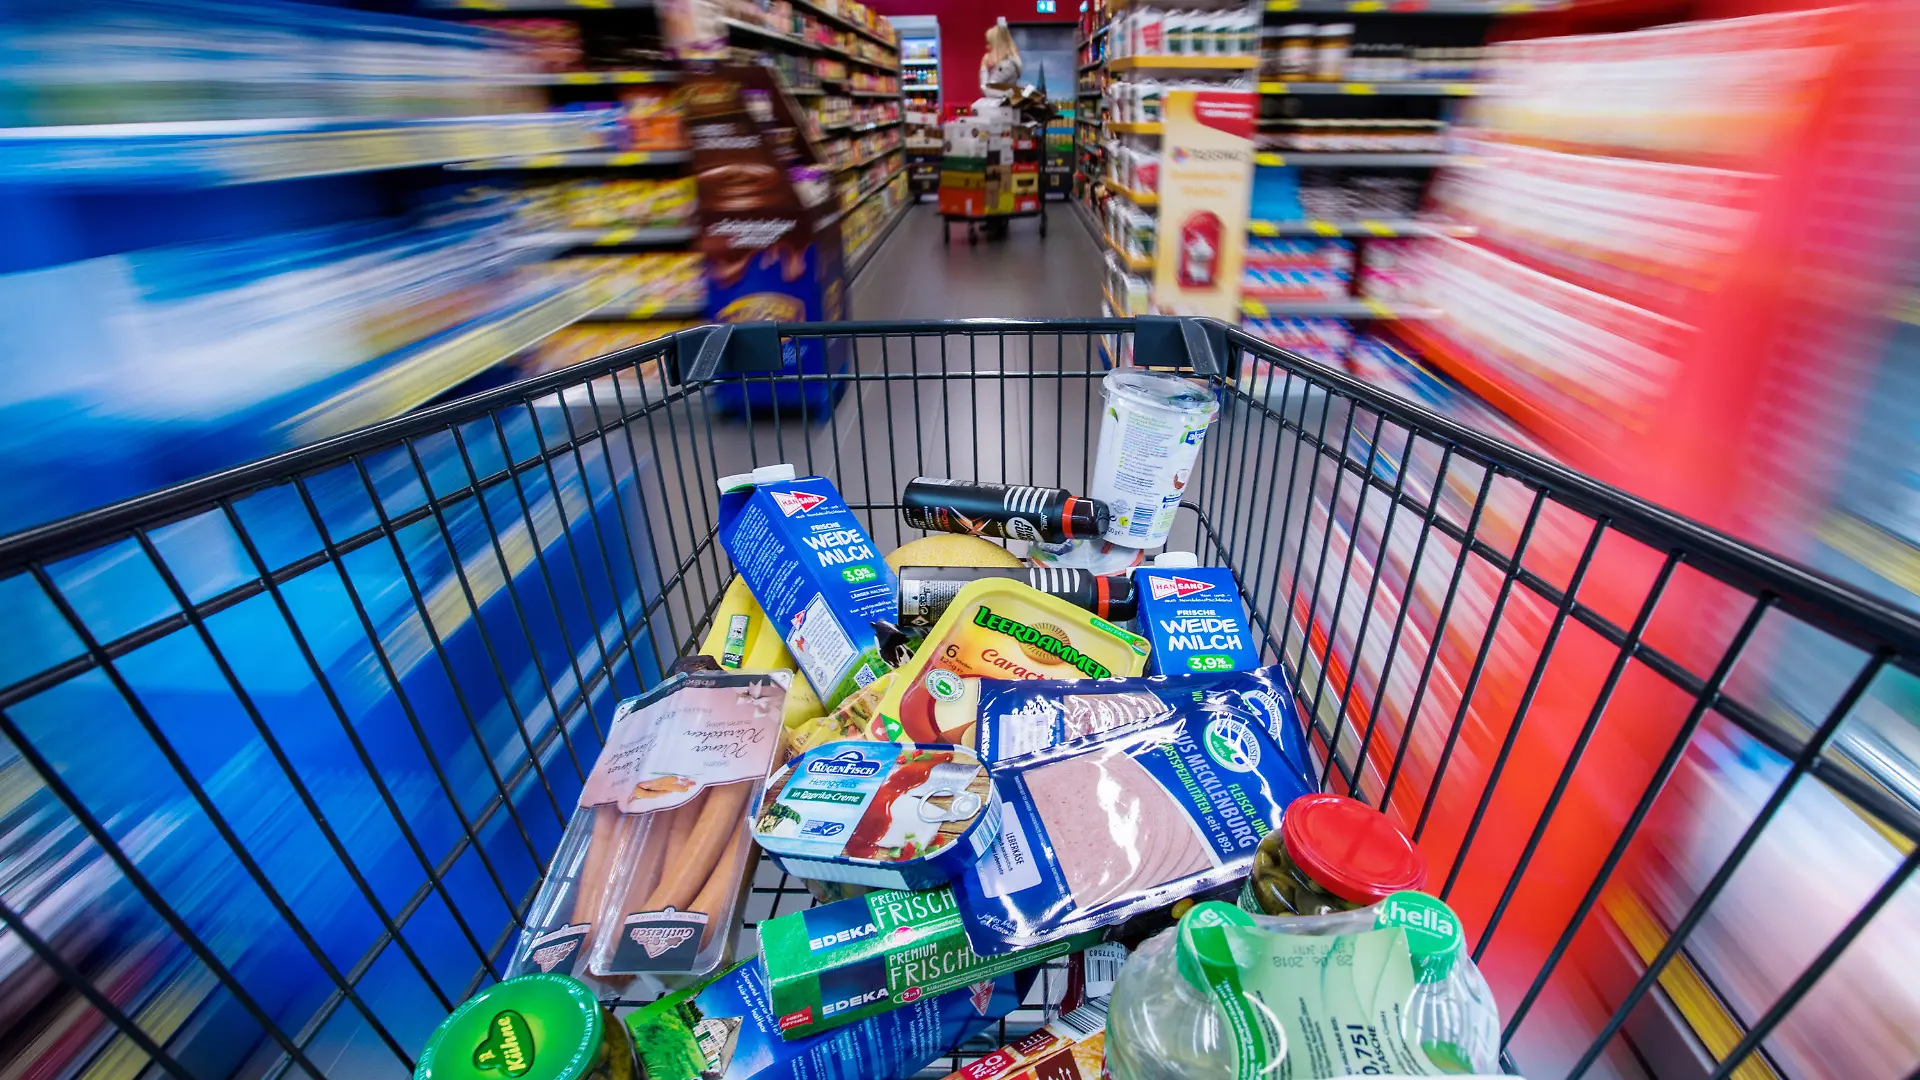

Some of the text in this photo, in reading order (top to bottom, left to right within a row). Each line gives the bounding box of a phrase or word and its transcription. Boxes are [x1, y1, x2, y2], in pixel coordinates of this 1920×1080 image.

[810, 522, 841, 531] FRISCHE
[802, 529, 865, 551] WEIDE
[818, 544, 874, 568] MILCH
[1156, 582, 1204, 590] HANSANO
[1160, 618, 1239, 634] WEIDE
[946, 644, 960, 658] 6
[973, 605, 1111, 680] LEERDAMMER
[1168, 635, 1243, 651] MILCH
[981, 648, 1054, 680] Caract
[1190, 657, 1226, 670] 3,9%
[683, 727, 765, 744] Würstchen
[691, 742, 748, 759] Wiener
[1161, 739, 1236, 854] URSTSPEZIALITÄTEN seit 1892
[1187, 752, 1259, 849] MECKLENBURG
[1227, 782, 1258, 819] FLEISCH-
[1006, 832, 1025, 865] LEBERKÄSE
[1390, 901, 1453, 936] hella
[632, 927, 693, 939] Gutfleisch
[809, 922, 878, 951] EDEKA
[889, 942, 938, 967] PREMIUM
[739, 967, 761, 997] Schonend
[737, 984, 753, 1007] kürzer
[750, 1007, 768, 1033] haltbar
[822, 987, 889, 1016] EDEKA
[786, 1013, 803, 1021] HIER
[498, 1016, 526, 1071] Kühne
[969, 1054, 1003, 1075] 20
[974, 1060, 1007, 1079] Meter
